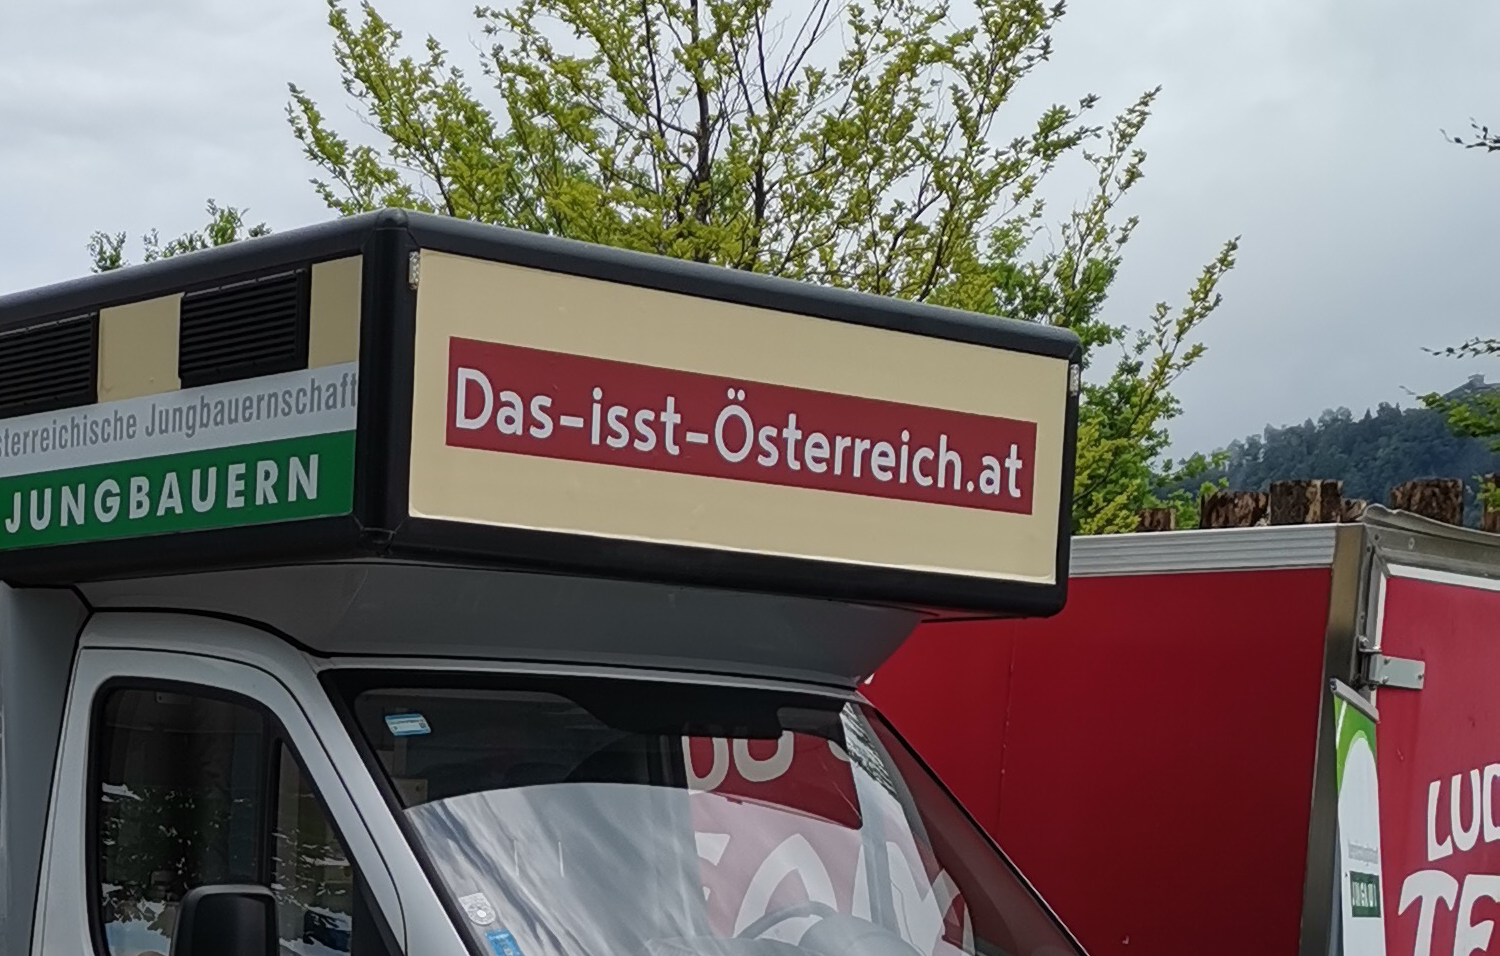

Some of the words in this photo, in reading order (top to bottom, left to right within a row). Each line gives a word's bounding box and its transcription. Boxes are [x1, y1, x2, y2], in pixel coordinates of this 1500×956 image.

[145, 372, 358, 438] Jungbauernschaft
[455, 367, 1023, 499] Das-isst-Österreich.at
[5, 453, 320, 534] JUNGBAUERN
